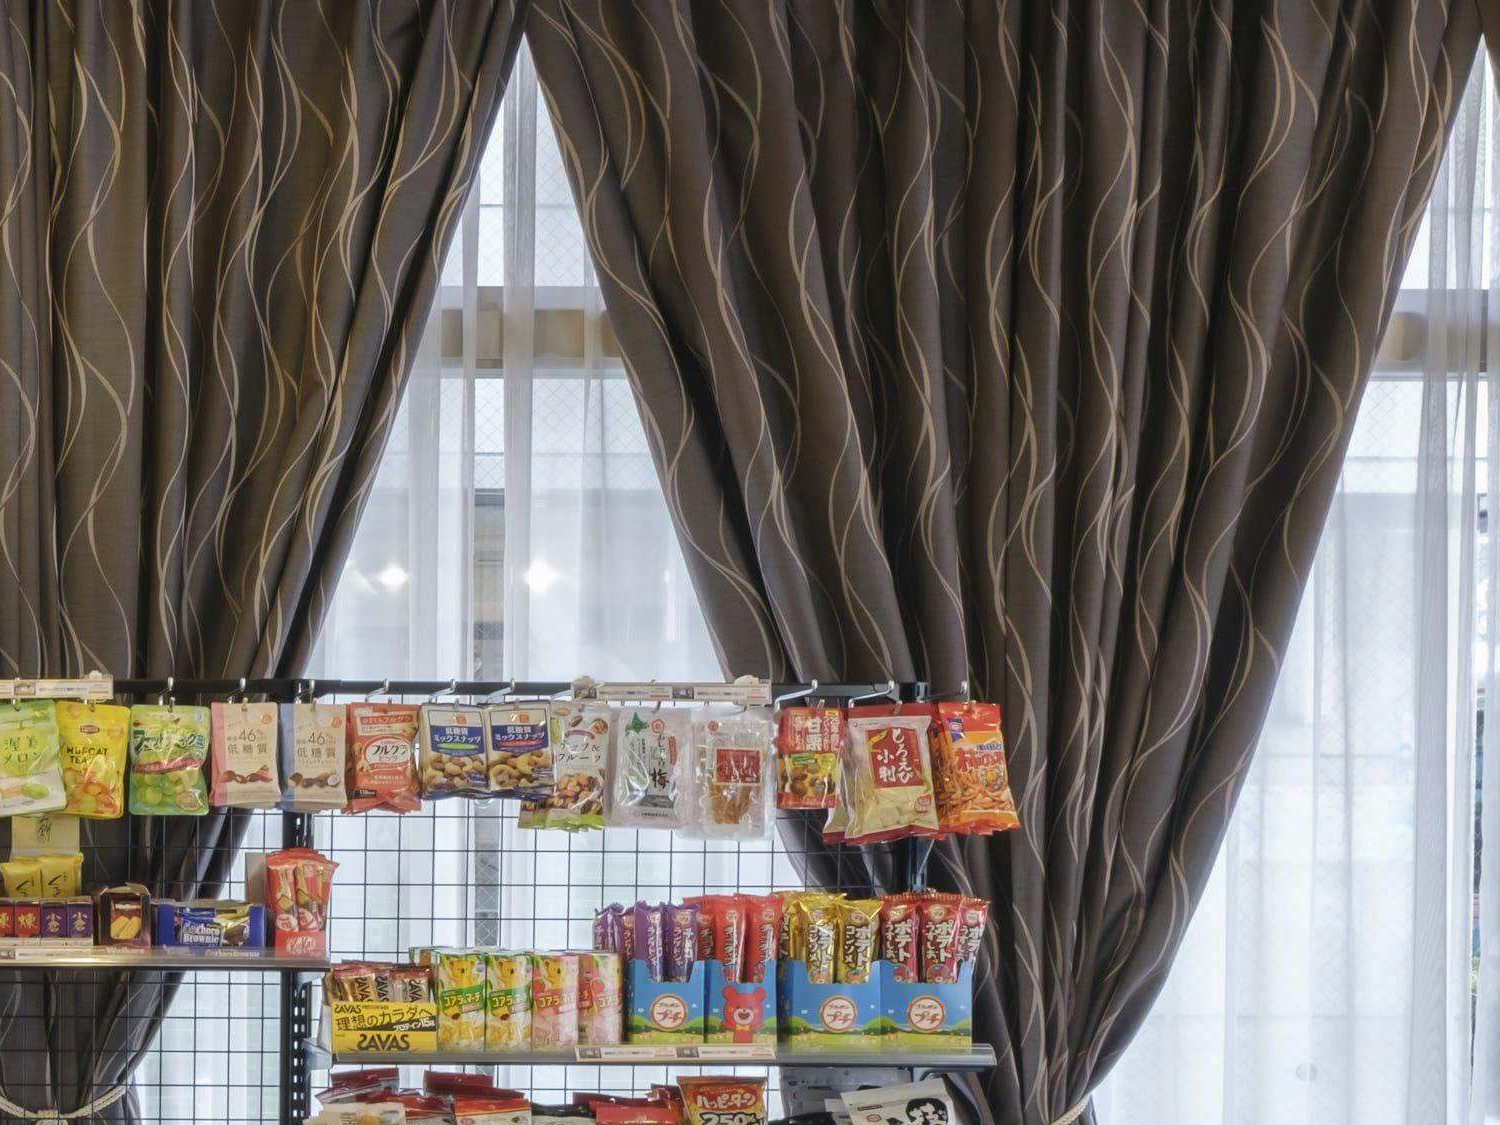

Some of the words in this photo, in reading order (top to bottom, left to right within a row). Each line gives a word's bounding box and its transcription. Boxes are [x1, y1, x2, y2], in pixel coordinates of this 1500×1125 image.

[238, 730, 257, 743] 46
[307, 732, 326, 746] 46
[371, 743, 408, 756] フルグラ
[890, 728, 913, 784] しろえび
[3, 752, 44, 765] メロン
[69, 756, 90, 764] TEA
[844, 924, 855, 964] コンソメ
[855, 921, 872, 967] ポテト
[895, 918, 912, 964] ポテト
[925, 922, 937, 960] うすしお
[937, 918, 955, 964] ポテト
[334, 1004, 362, 1014] SAVAS
[336, 1006, 434, 1031] 理想のカラダへ
[656, 1010, 681, 1025] プチ
[827, 1011, 851, 1025] プチ
[915, 1011, 940, 1024] プチ
[357, 1033, 411, 1051] SAVAS
